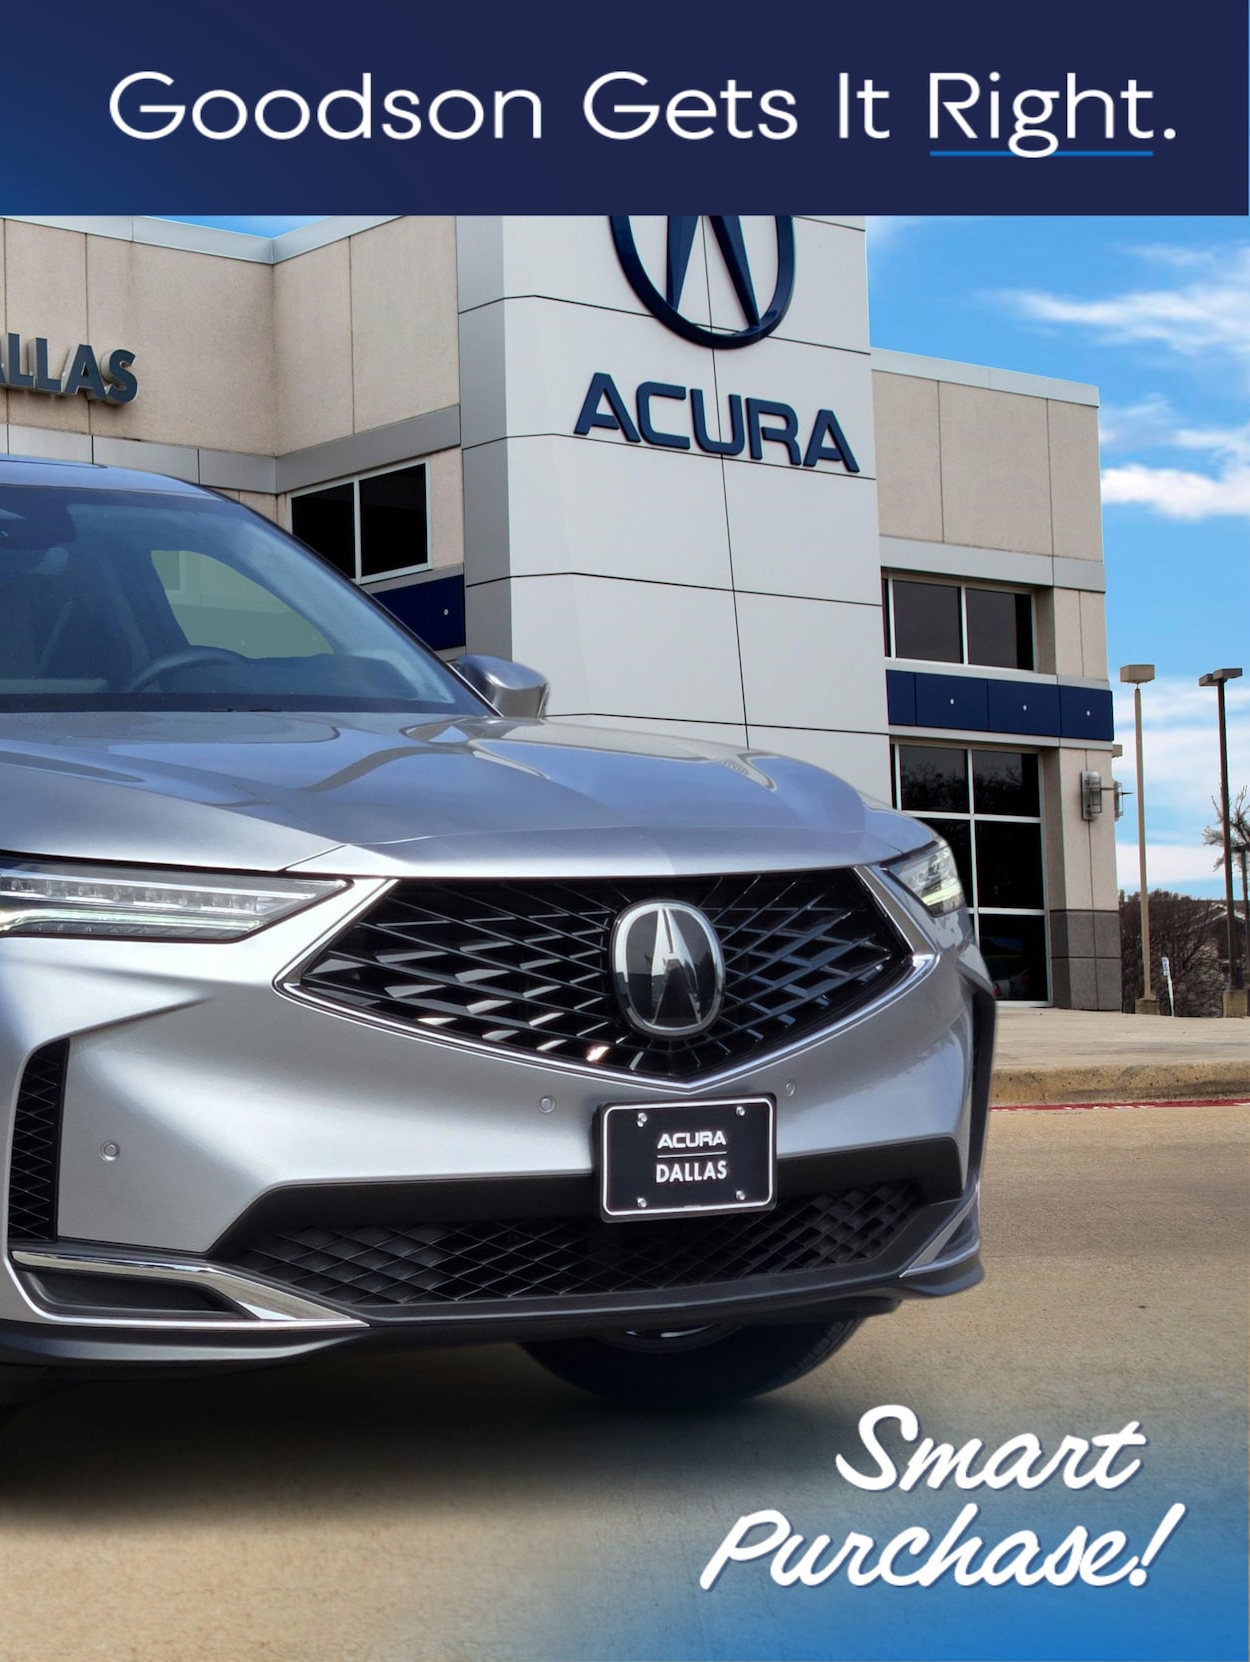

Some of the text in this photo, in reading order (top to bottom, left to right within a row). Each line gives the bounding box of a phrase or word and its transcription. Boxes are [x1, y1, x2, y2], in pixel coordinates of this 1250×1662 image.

[573, 371, 860, 473] ACURA
[656, 1130, 727, 1149] ACURA
[655, 1160, 728, 1183] DALLAS
